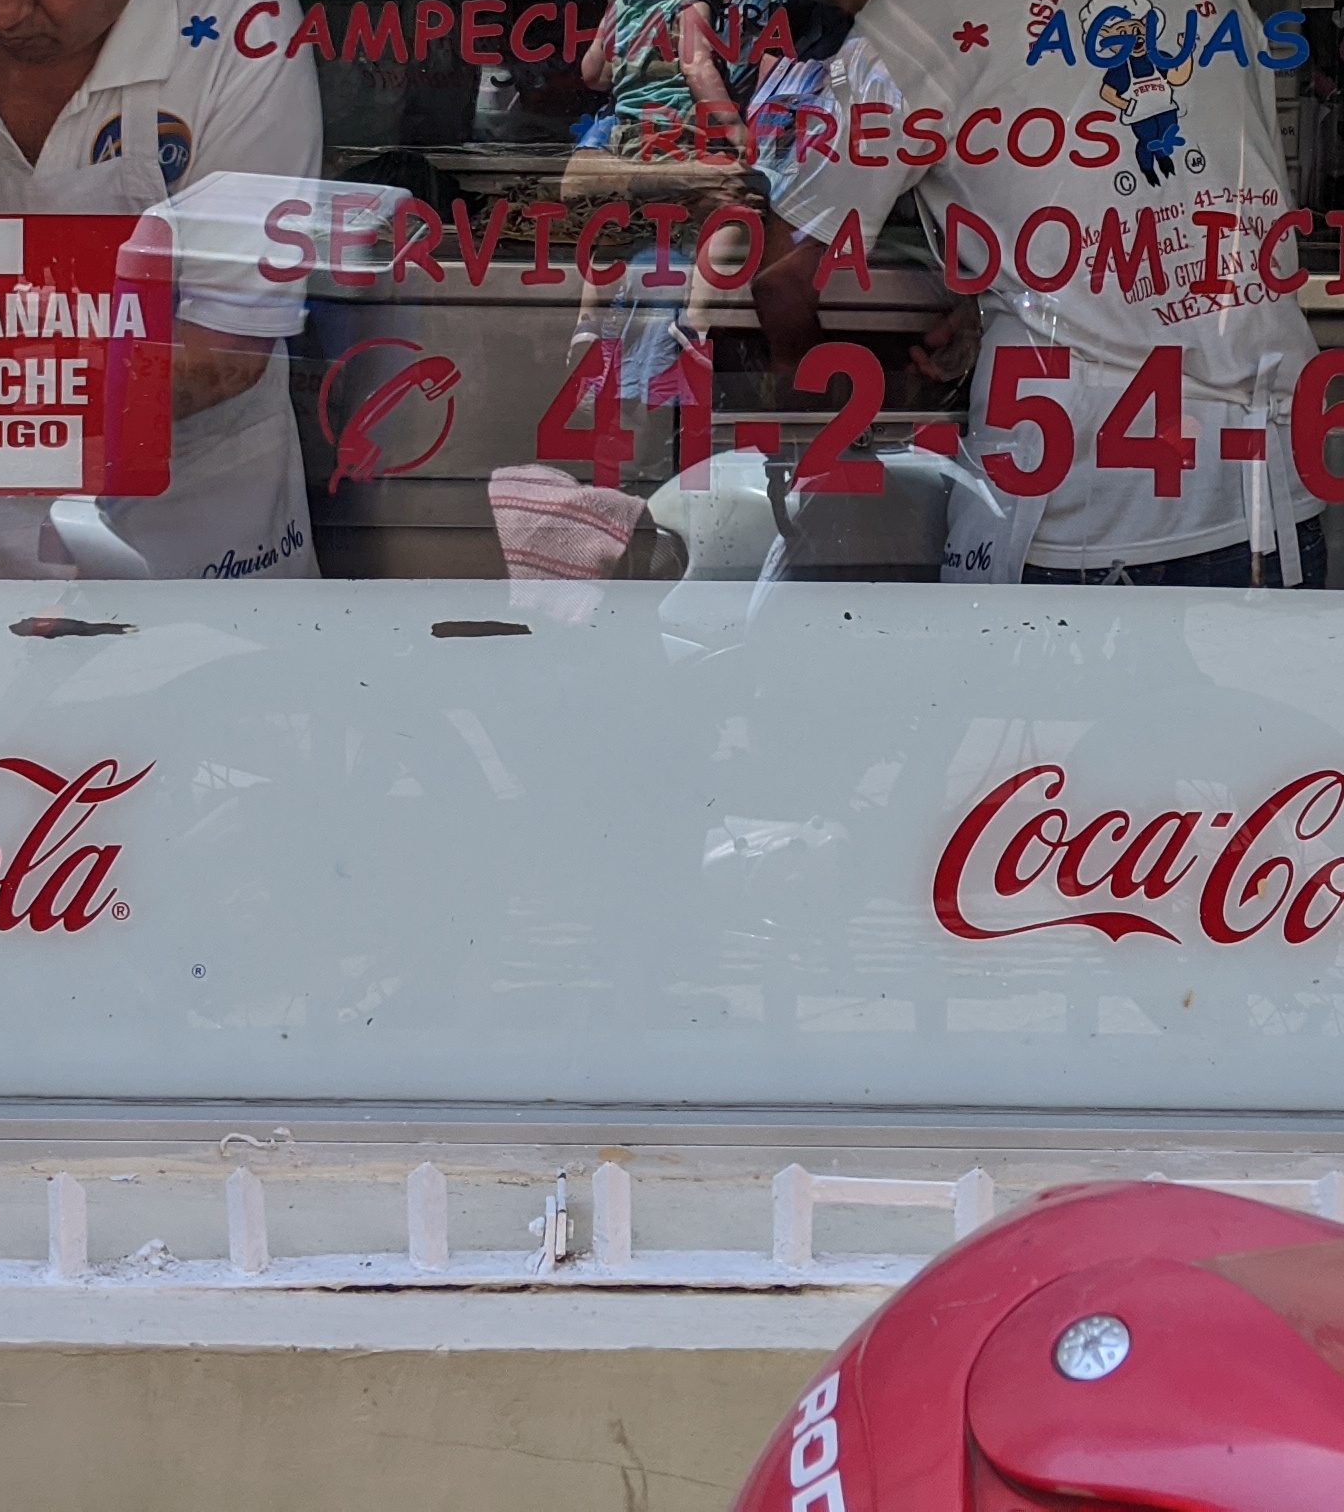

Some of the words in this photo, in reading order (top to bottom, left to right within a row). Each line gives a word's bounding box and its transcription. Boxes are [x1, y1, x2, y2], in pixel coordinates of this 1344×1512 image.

[1026, 4, 1310, 72] AGUAS
[639, 99, 1120, 169] REFRESCOS
[257, 192, 765, 290] SERVICIO
[813, 208, 871, 292] A
